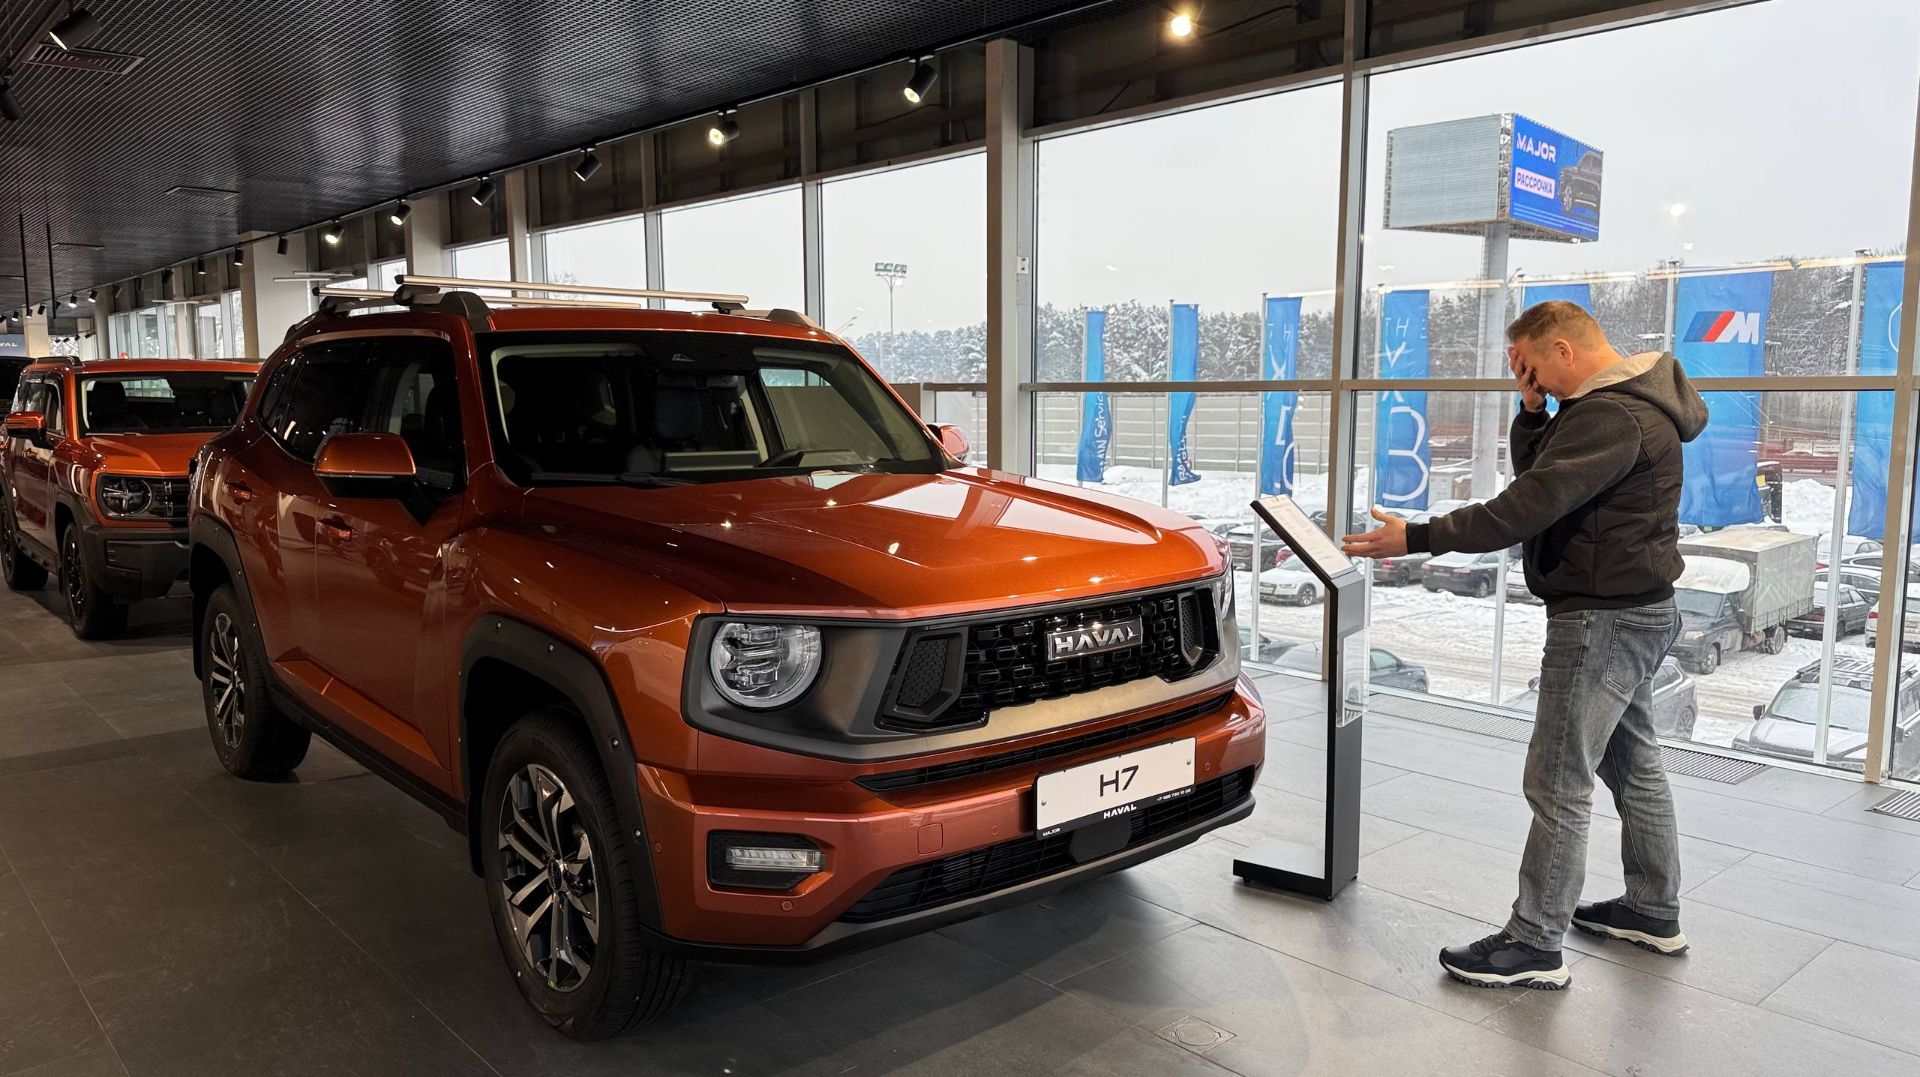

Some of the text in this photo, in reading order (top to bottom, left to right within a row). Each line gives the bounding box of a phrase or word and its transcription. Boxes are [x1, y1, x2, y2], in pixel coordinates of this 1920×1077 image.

[1516, 132, 1556, 163] MAJOR
[1517, 172, 1552, 194] РАССРОЧКА
[1054, 625, 1139, 654] HAVAL
[1099, 765, 1139, 797] H7
[1103, 803, 1137, 820] HAVAL
